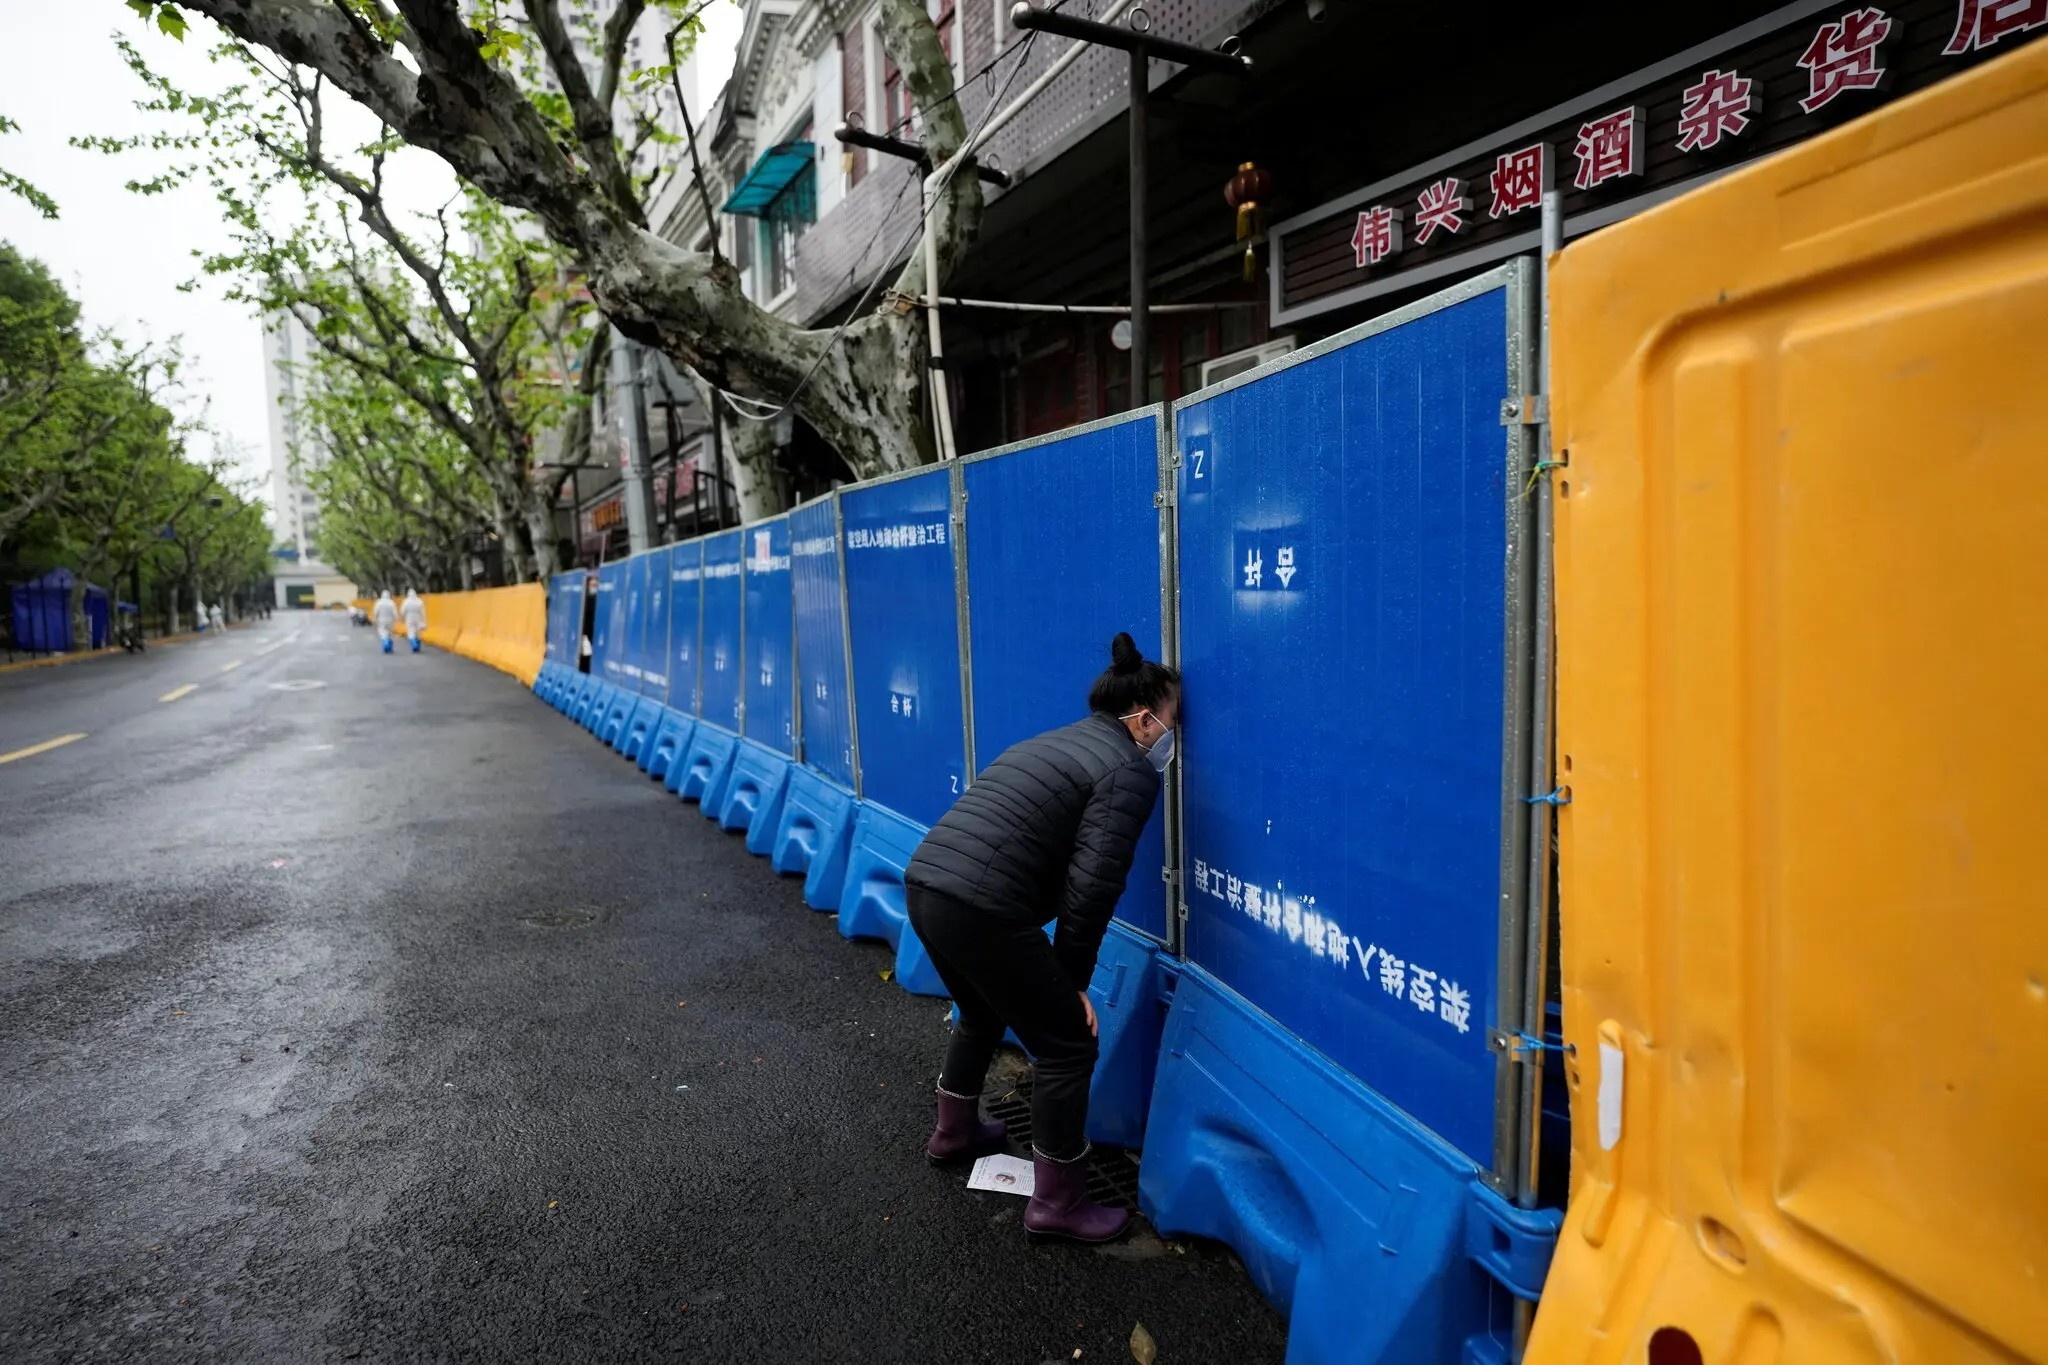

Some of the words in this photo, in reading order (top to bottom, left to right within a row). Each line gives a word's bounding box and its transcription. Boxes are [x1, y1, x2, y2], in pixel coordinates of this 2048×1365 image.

[1244, 546, 1297, 590] 合杆
[1194, 857, 1471, 1034] 架空线入地和合杆整治工程
